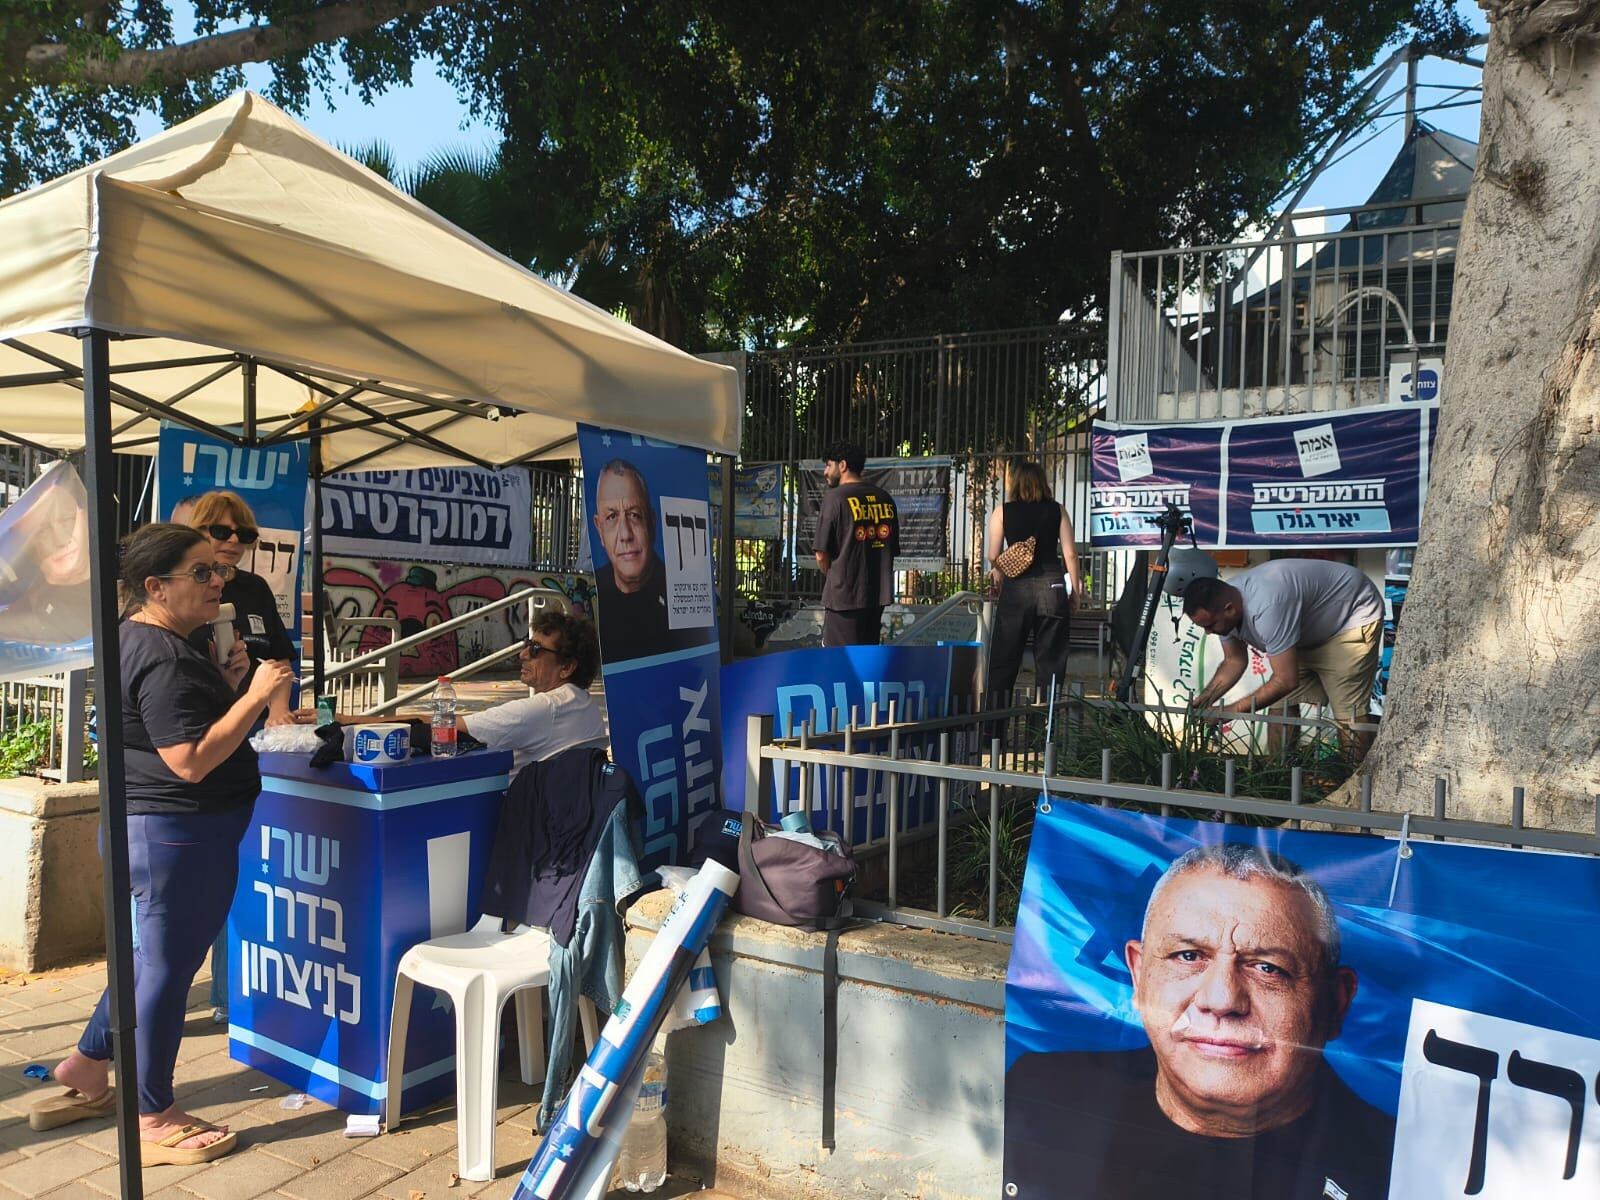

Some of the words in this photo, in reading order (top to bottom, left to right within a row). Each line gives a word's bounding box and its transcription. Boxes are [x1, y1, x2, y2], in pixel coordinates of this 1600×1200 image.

[183, 442, 289, 490] ישר!
[1299, 434, 1333, 454] אמת
[321, 487, 509, 545] דמוקרטית
[1254, 484, 1384, 505] הדמוקרטים
[1317, 512, 1361, 528] יאיר
[665, 512, 707, 571] דרך
[1100, 514, 1130, 532] גולן
[1276, 512, 1316, 531] גולן
[261, 825, 340, 886] ישר!
[254, 880, 347, 953] בדרך
[241, 940, 361, 1025] לניצחון
[1423, 1028, 1600, 1196] רך
